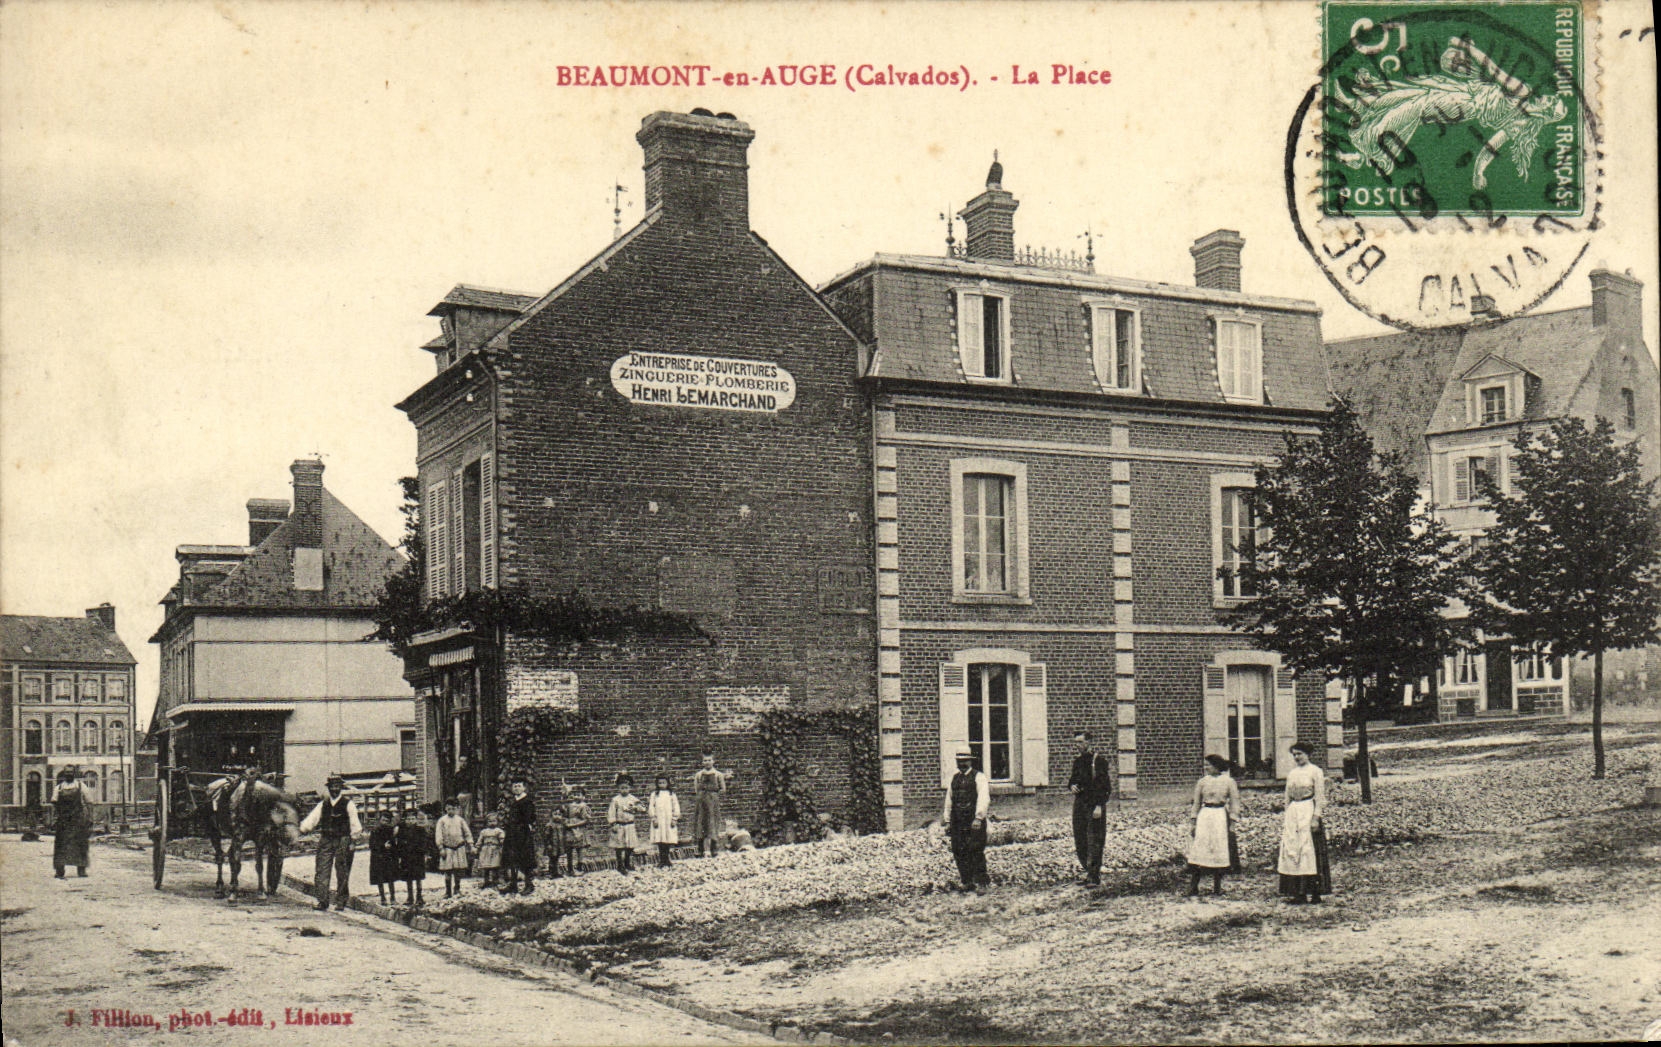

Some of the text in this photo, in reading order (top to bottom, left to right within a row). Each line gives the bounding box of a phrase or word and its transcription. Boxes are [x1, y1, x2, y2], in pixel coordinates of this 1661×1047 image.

[629, 354, 692, 370] ENTREPRISE
[706, 359, 778, 378] COUVERTURES
[619, 367, 790, 392] ZINGUERIE PLOMBERIE
[632, 384, 777, 410] HENRI LEMARCHAND
